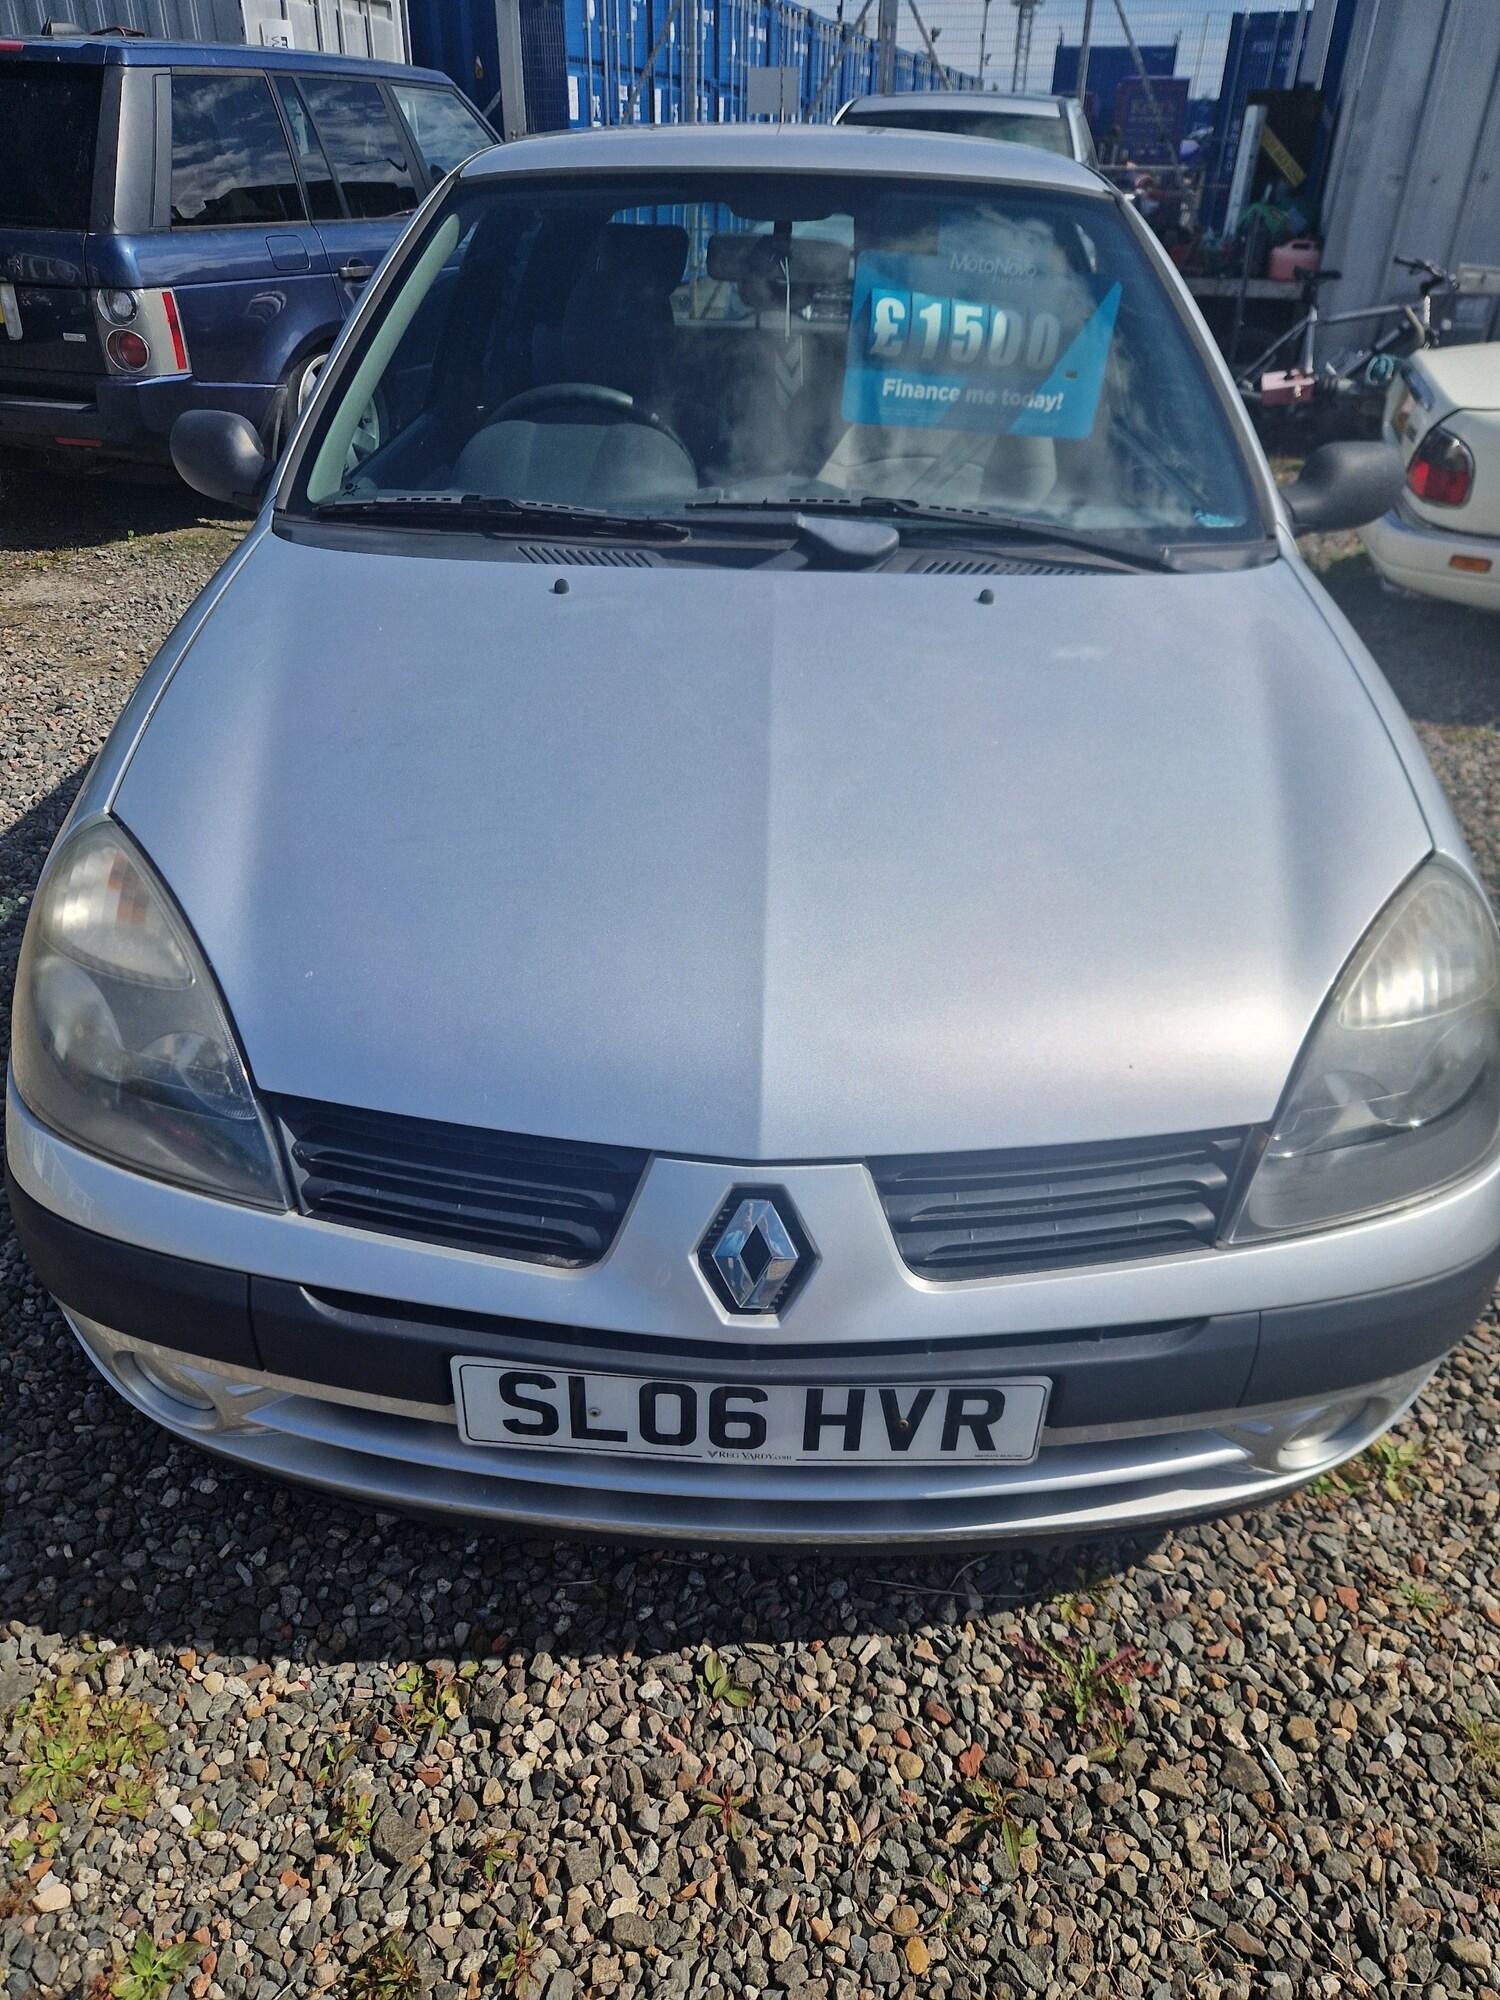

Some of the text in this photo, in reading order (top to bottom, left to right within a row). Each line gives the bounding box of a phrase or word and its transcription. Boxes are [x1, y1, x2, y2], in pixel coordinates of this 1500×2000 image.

[870, 296, 1061, 371] £1500
[881, 377, 1065, 412] Finance me today!
[499, 1371, 1006, 1452] SL06 HVR
